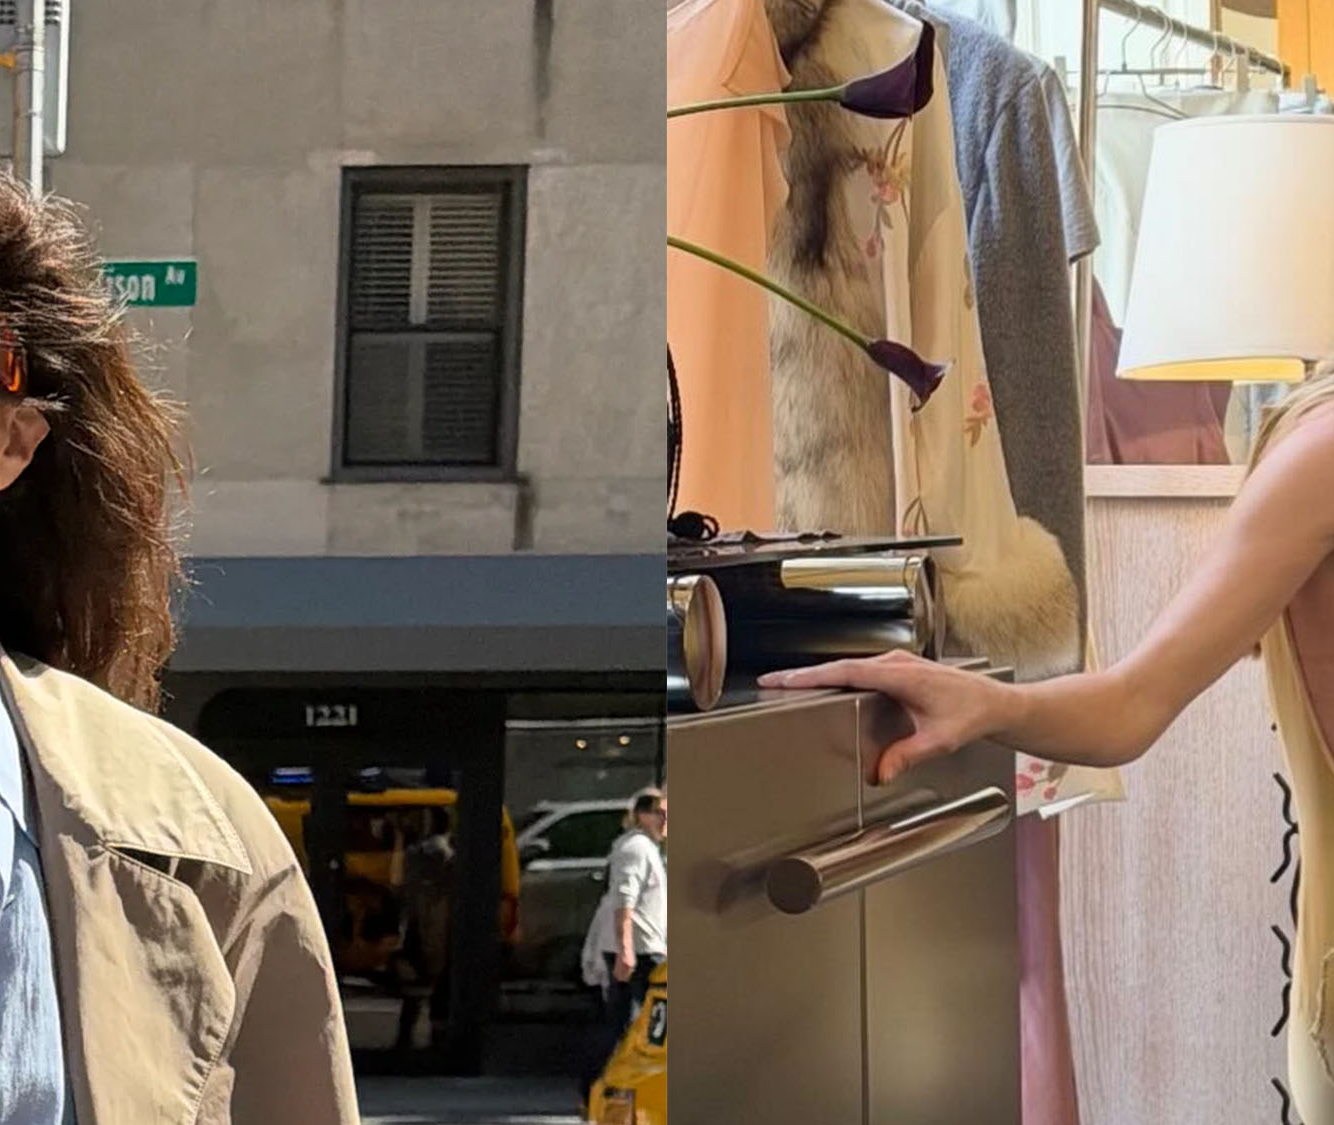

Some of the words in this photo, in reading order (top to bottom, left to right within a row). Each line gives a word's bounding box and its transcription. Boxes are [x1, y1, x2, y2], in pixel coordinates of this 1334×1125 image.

[106, 269, 156, 301] ison
[165, 265, 185, 285] Av
[305, 704, 357, 727] 1221
